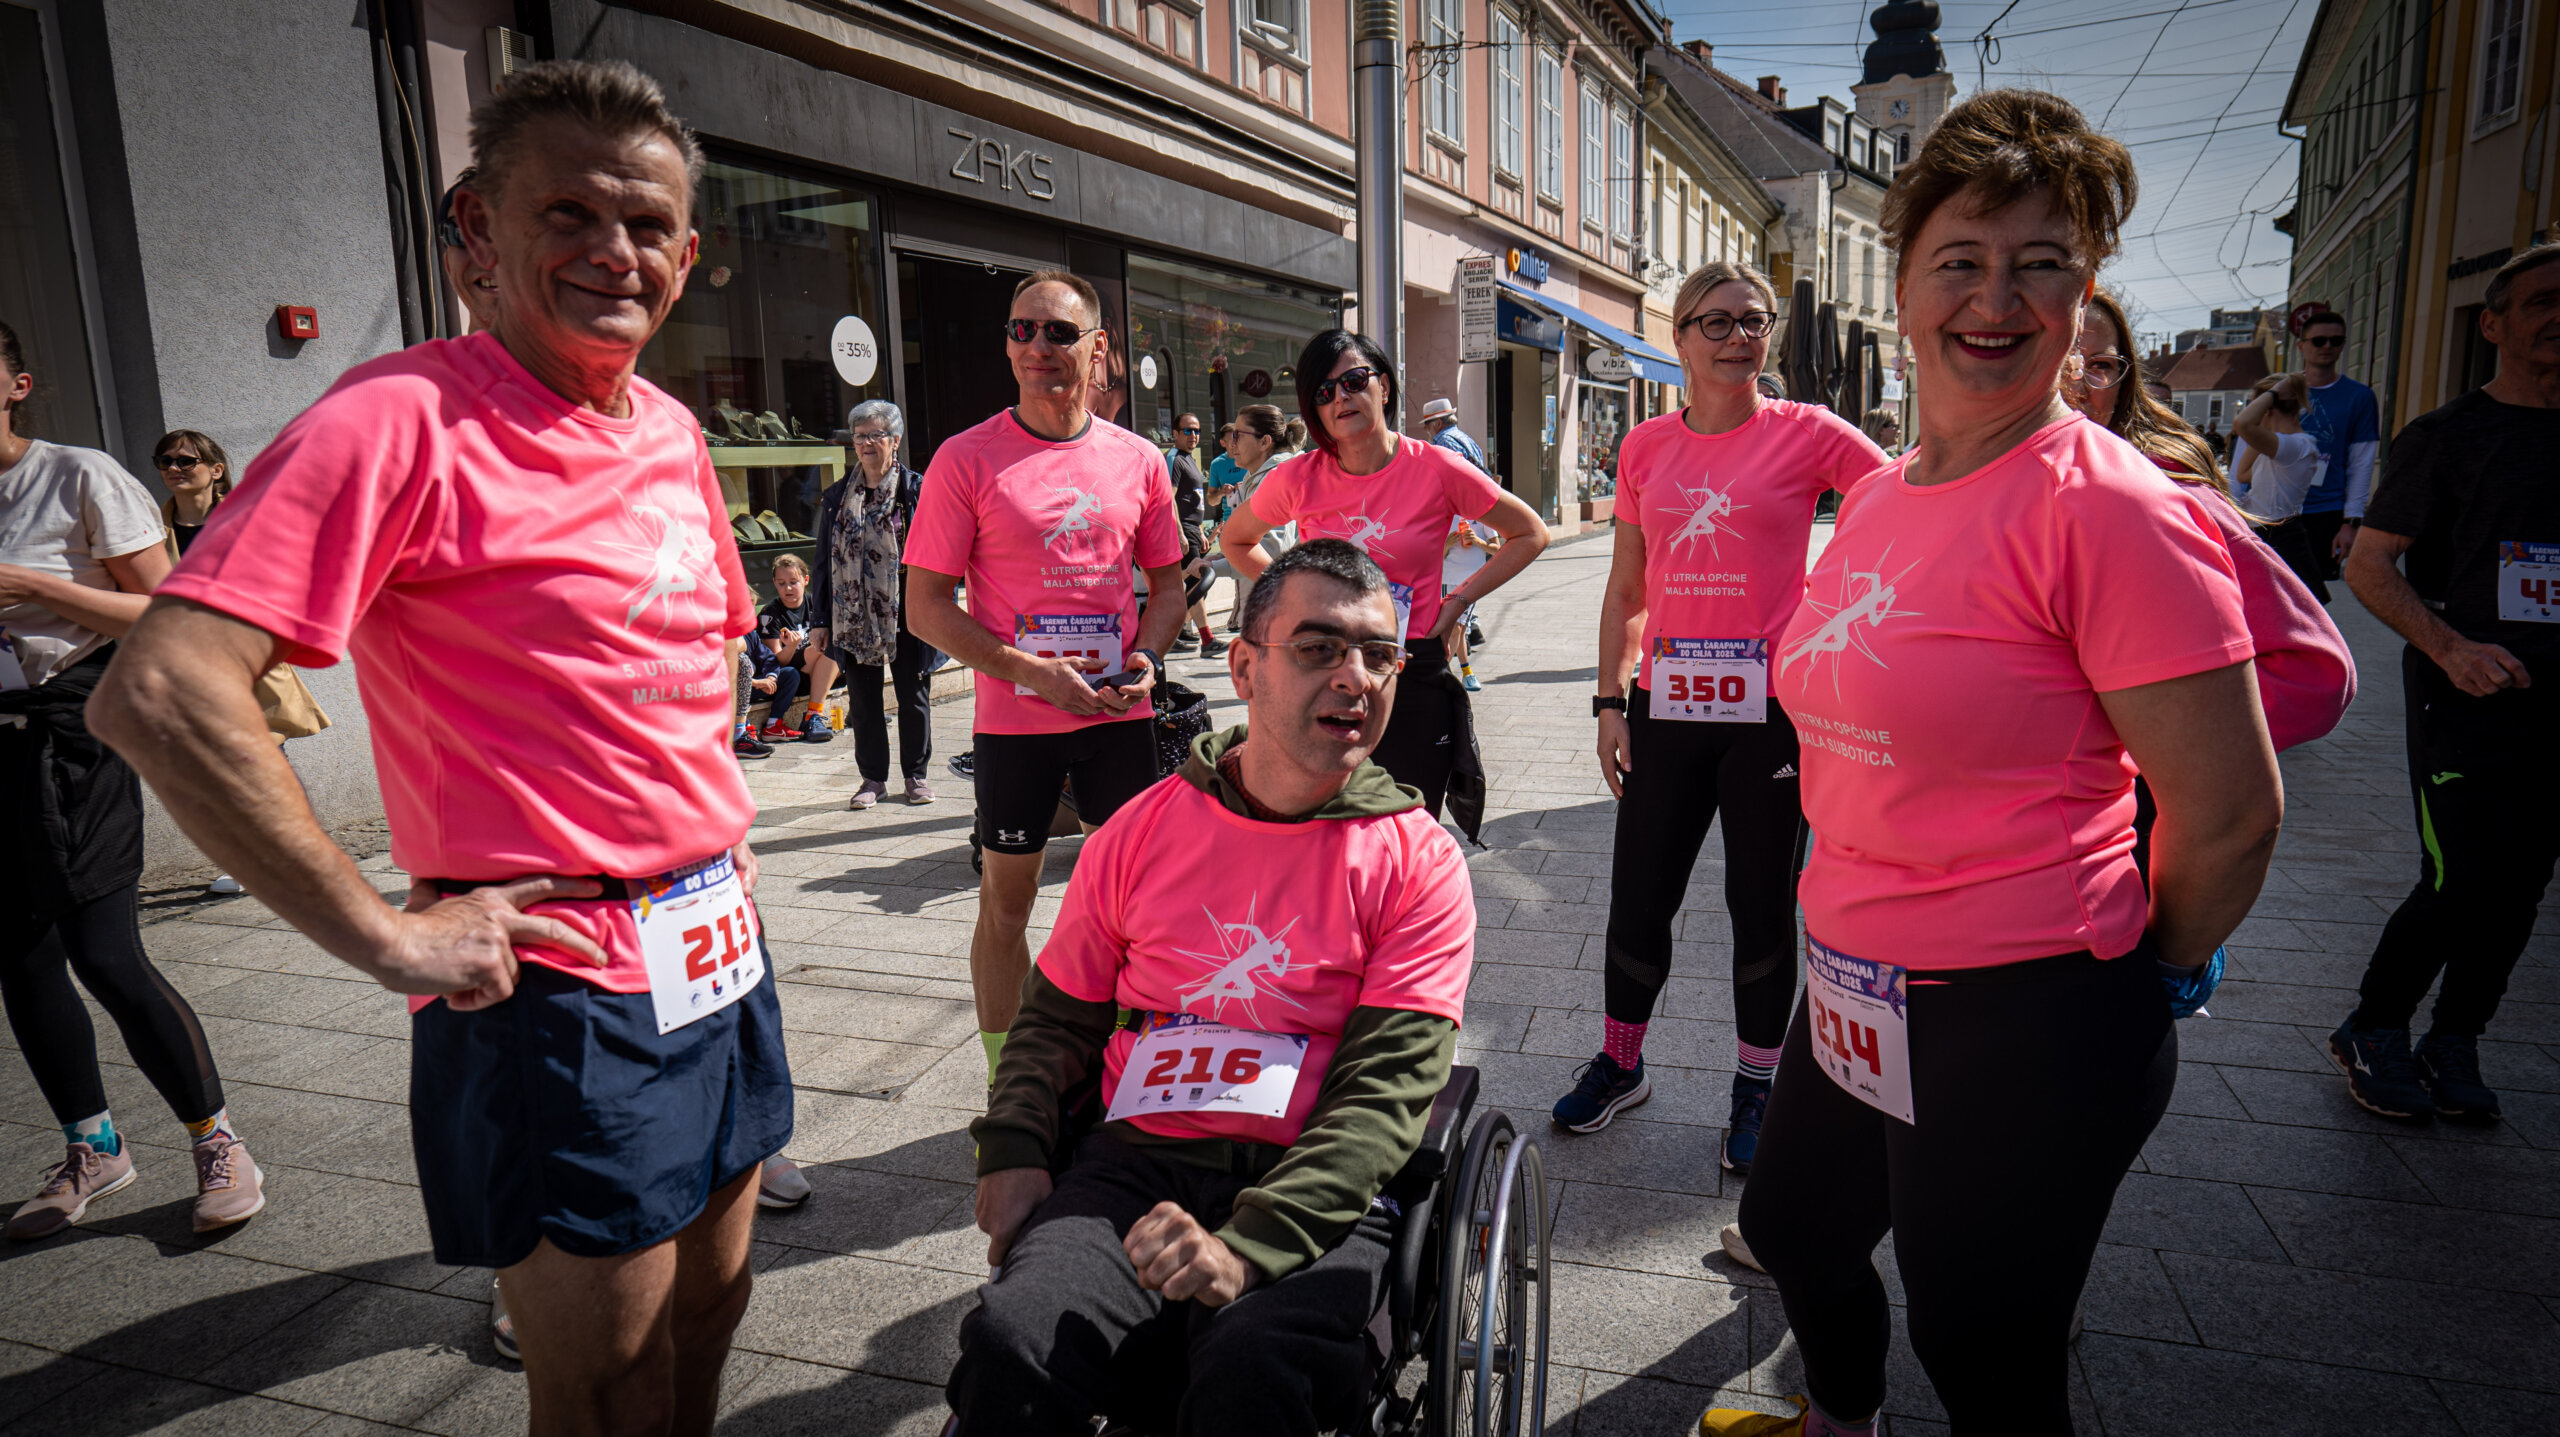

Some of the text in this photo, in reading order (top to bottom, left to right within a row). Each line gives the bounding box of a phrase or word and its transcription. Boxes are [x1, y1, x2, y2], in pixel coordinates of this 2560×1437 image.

[948, 126, 1056, 200] ZAKS
[1465, 260, 1491, 270] EXPRES
[1519, 249, 1549, 283] mlinar
[1468, 275, 1489, 284] SERVIS
[1041, 567, 1049, 576] 5.
[1051, 566, 1085, 575] UTRKA
[1673, 573, 1706, 582] UTRKA
[1043, 577, 1119, 588] MALA SUBOTICA
[1665, 586, 1746, 597] MALA SUBOTICA
[1059, 625, 1079, 633] CILJA
[1704, 639, 1745, 650] ČARAPAMA
[1680, 649, 1690, 657] DO
[1692, 649, 1712, 658] CILJA
[622, 663, 641, 679] 5.
[643, 659, 698, 677] UTRKA
[632, 685, 681, 705] MALA
[1668, 674, 1746, 704] 350
[1794, 711, 1834, 732] UTRKA
[1827, 737, 1896, 767] SUBOTICA
[1773, 771, 1797, 779] adidas
[684, 873, 702, 892] DO
[1826, 949, 1875, 981] ČARAPAMA
[1179, 1015, 1194, 1025] DO
[1814, 995, 1881, 1077] 214
[1143, 1047, 1262, 1088] 216
